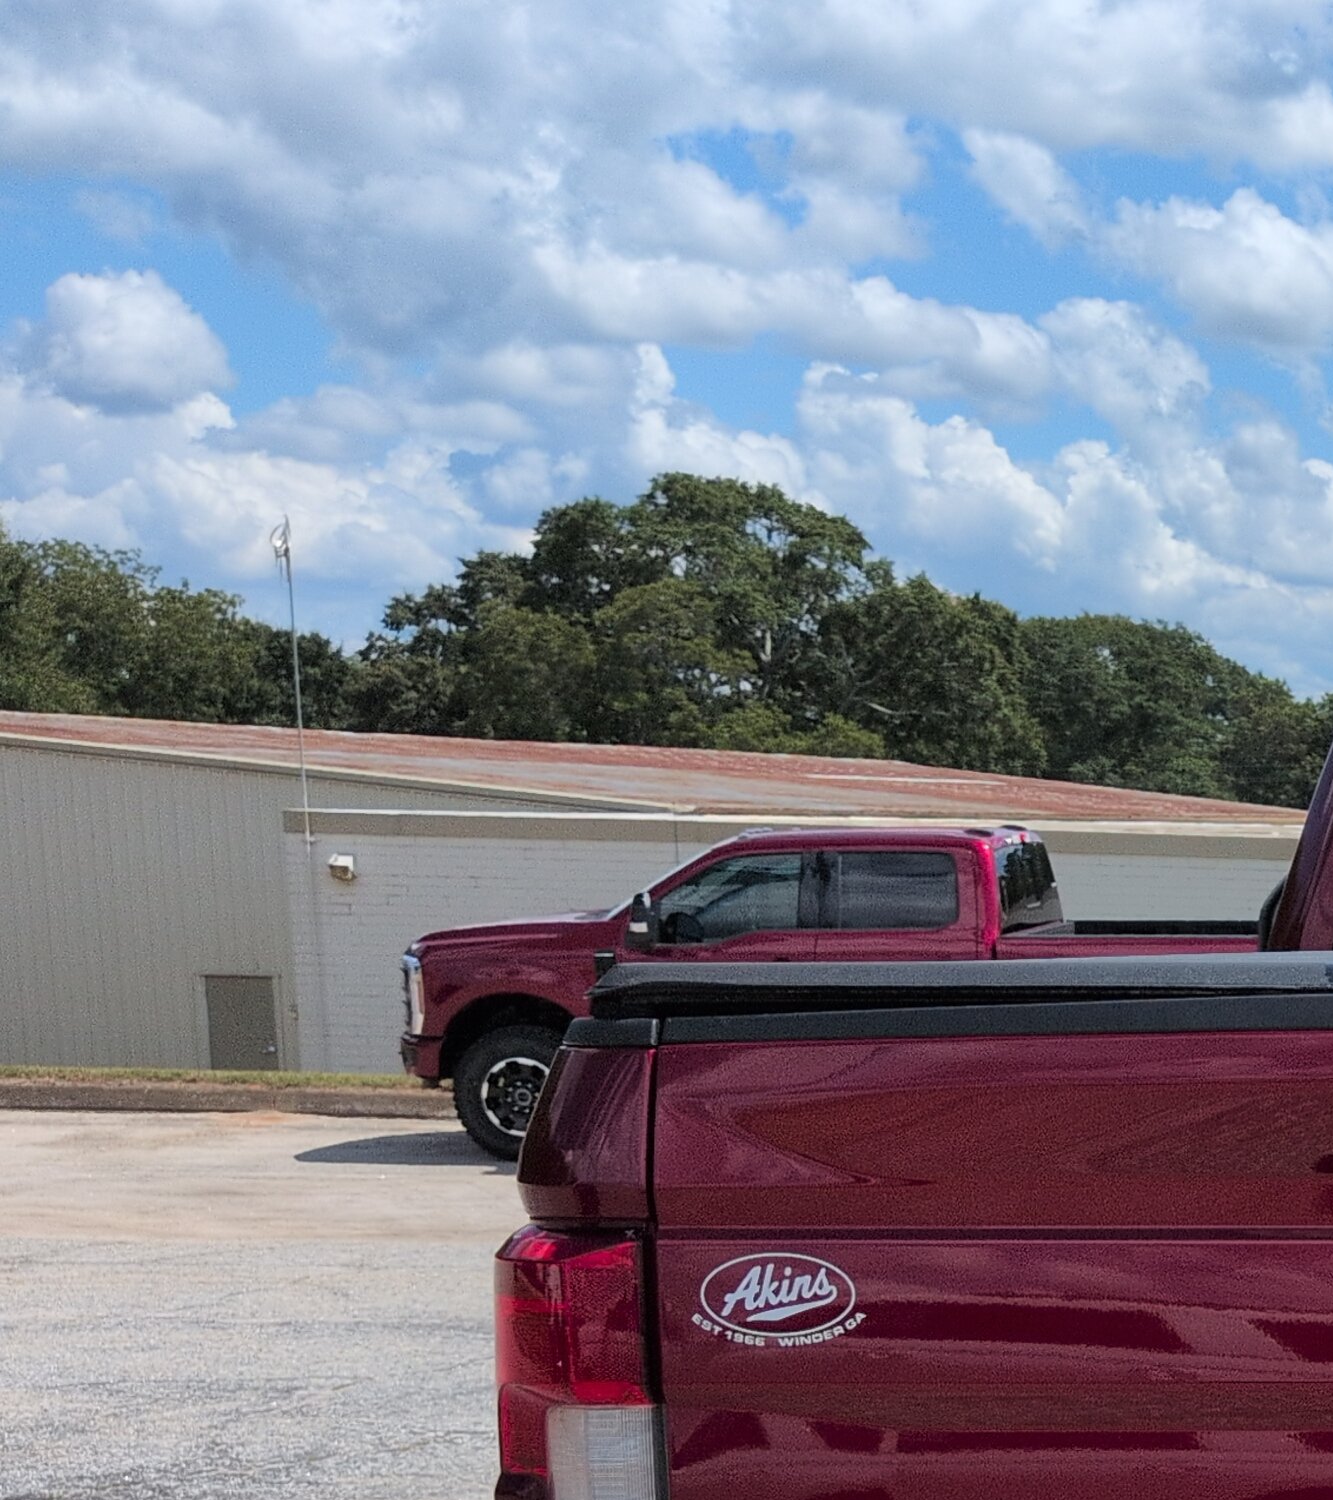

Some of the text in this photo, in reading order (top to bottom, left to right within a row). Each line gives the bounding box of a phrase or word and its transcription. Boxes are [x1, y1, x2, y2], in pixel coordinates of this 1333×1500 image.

[721, 1263, 838, 1320] Akins
[691, 1312, 722, 1335] EST
[778, 1325, 845, 1347] WINDER
[844, 1312, 867, 1331] GA
